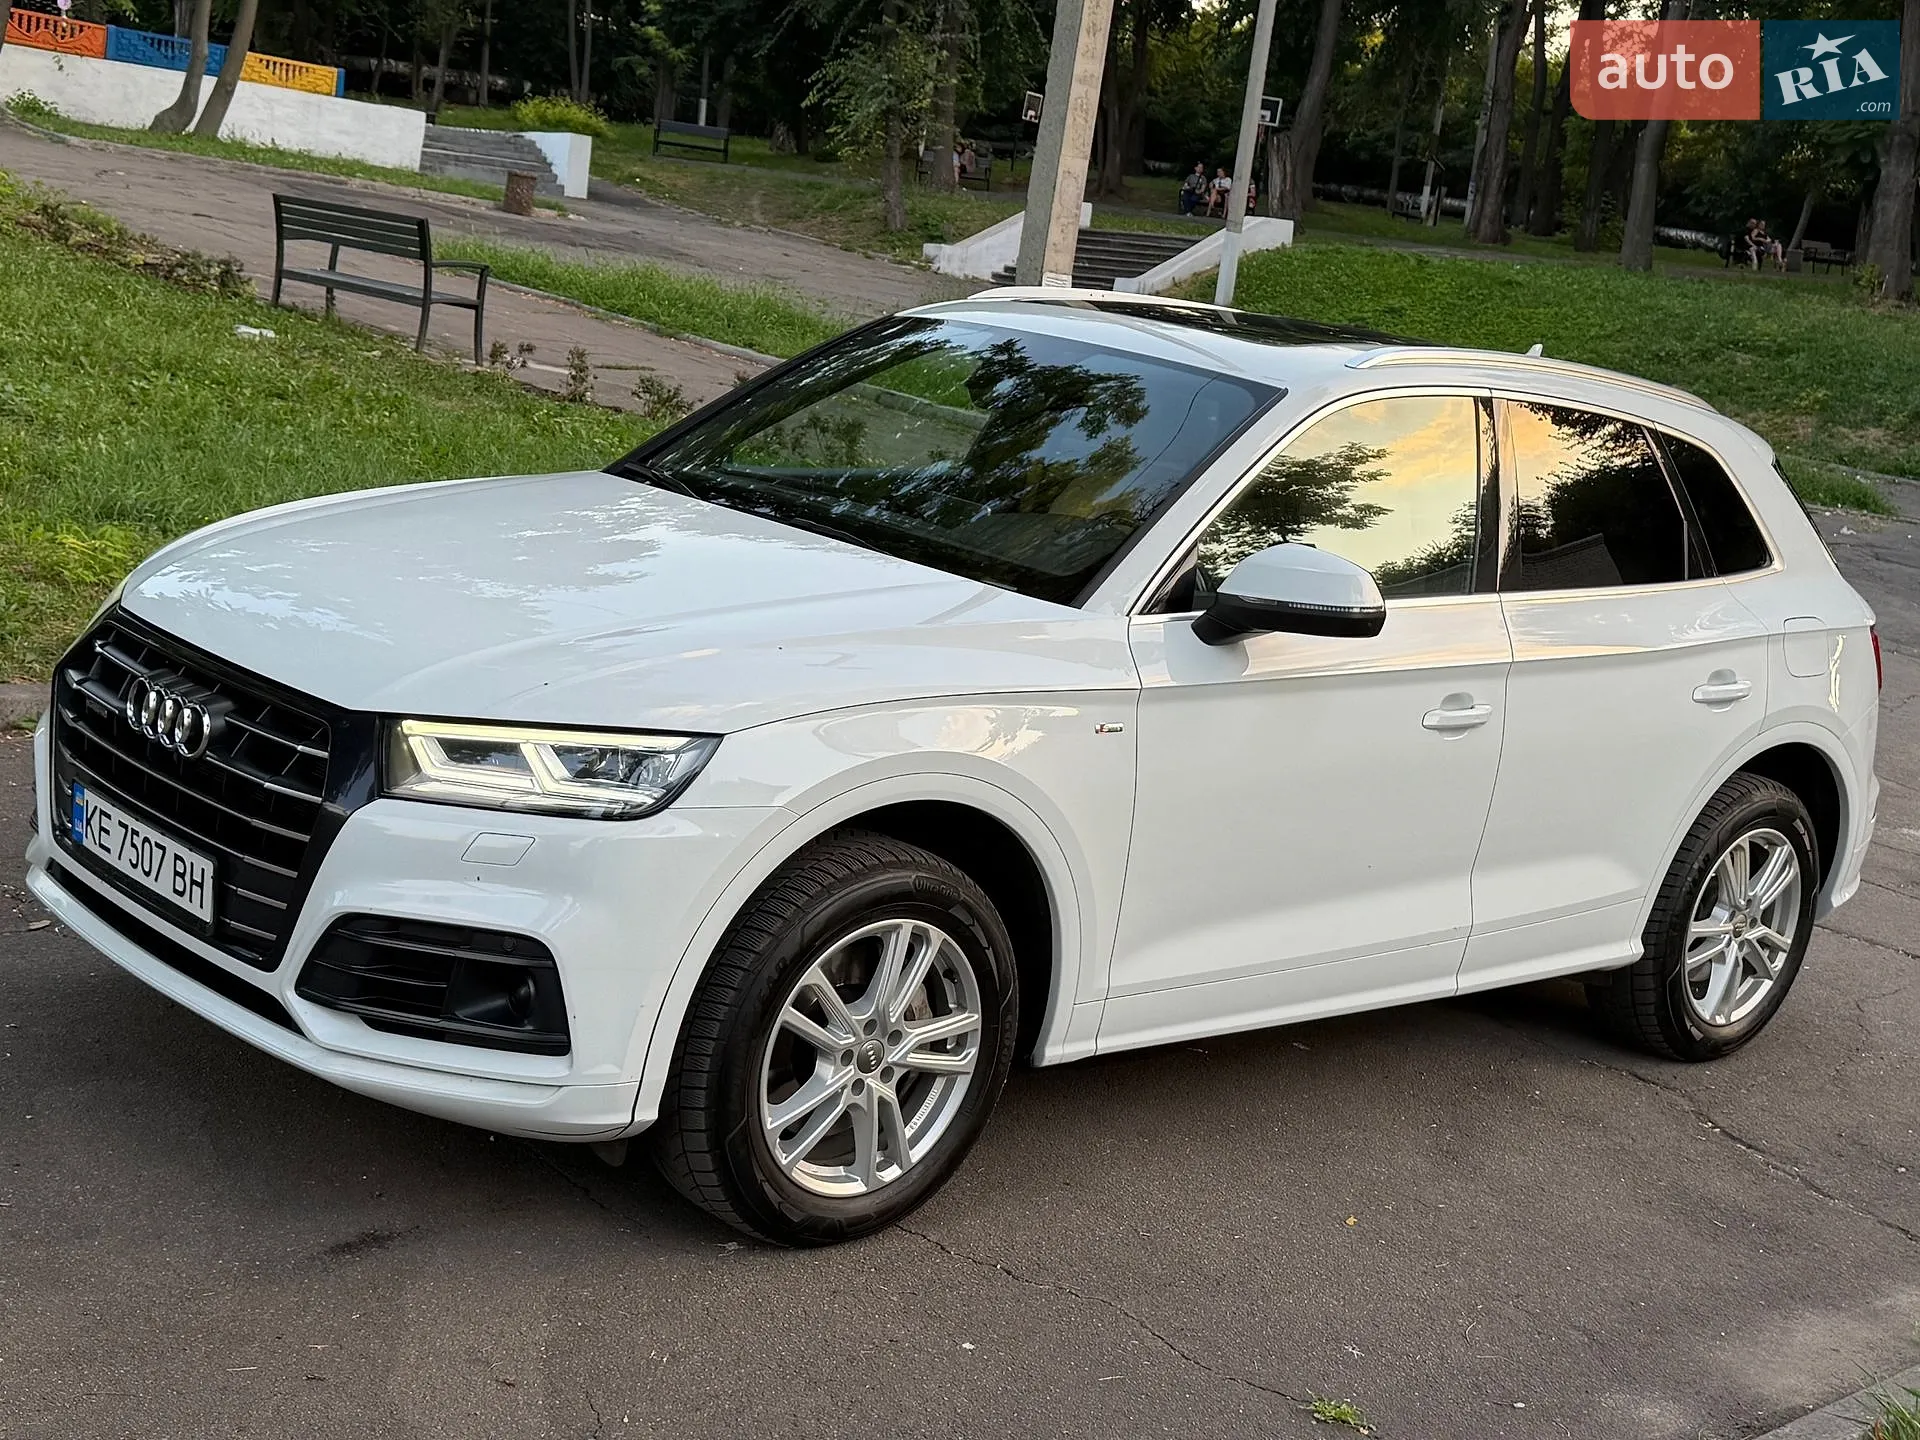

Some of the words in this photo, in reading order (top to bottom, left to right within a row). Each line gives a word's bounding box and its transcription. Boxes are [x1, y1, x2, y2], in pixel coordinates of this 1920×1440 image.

[85, 799, 112, 855] KE
[117, 819, 167, 883] 7507
[172, 852, 205, 909] BH
